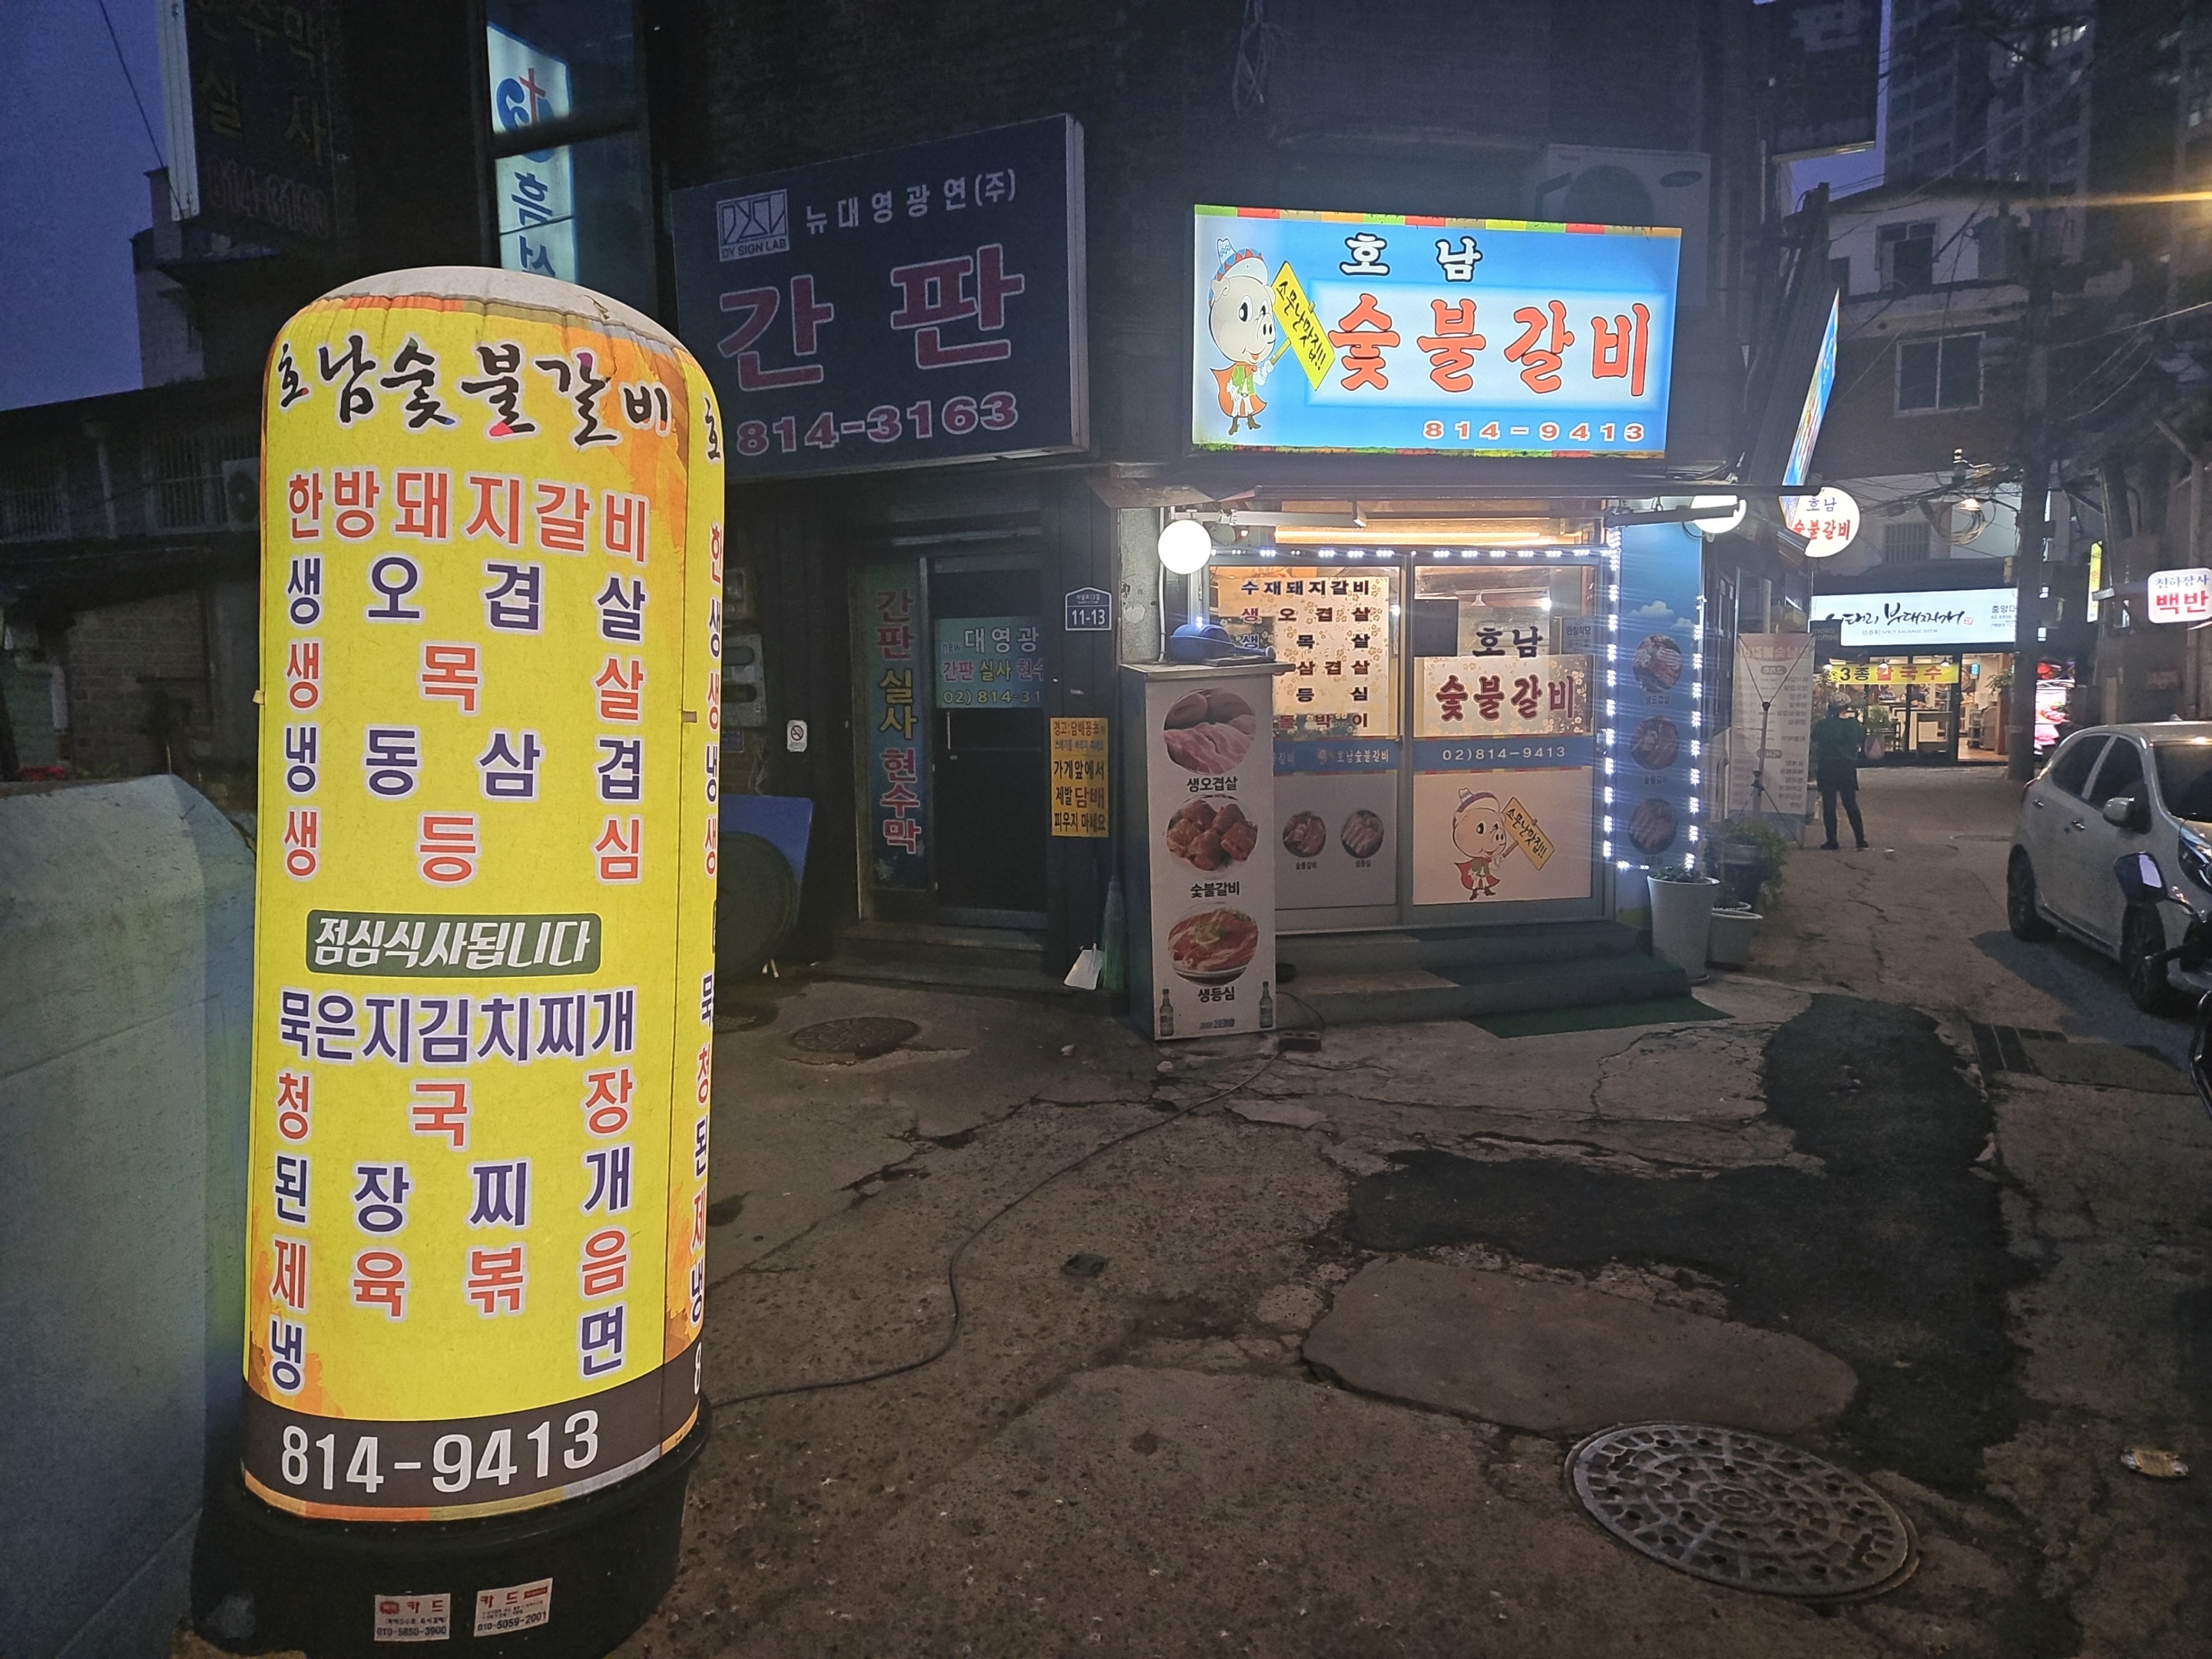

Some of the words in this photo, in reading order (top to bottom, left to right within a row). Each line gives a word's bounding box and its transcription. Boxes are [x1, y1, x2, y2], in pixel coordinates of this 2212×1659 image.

[723, 247, 735, 257] DY
[738, 243, 763, 256] SIGN
[767, 239, 786, 250] LAB
[1339, 233, 1482, 282] 호남
[717, 243, 1025, 392] 간판
[1329, 293, 1651, 396] 숯불갈비
[279, 334, 672, 445] 호남숯불갈비
[737, 392, 1018, 455] 814-3163
[1423, 421, 1644, 442] 814-9413
[289, 471, 645, 562] 한방돼지갈비
[1806, 497, 1836, 512] 호남
[1241, 580, 1369, 596] 수재돼지갈비
[2156, 591, 2209, 614] 백반
[876, 588, 916, 661] 간판
[1072, 609, 1105, 625] 11-13
[1472, 626, 1543, 658] 호남
[942, 661, 975, 682] 간판
[979, 659, 1012, 682] 실사
[1839, 665, 1870, 681] 3종
[879, 669, 918, 740] 실사
[1435, 674, 1575, 722] 숯불갈비
[1442, 747, 1565, 761] 02)814-9413
[1187, 775, 1238, 792] 생오겹살
[879, 747, 922, 855] 현수막
[1055, 786, 1072, 806] 제발
[1075, 786, 1104, 810] 담배
[1054, 812, 1078, 832] 피우지
[1190, 882, 1240, 898] 숯불갈비
[314, 918, 591, 969] 점심식사됩니다
[1197, 986, 1235, 1003] 생등심
[281, 990, 634, 1063] 묵은지김치찌개
[282, 1410, 598, 1493] 814-9413
